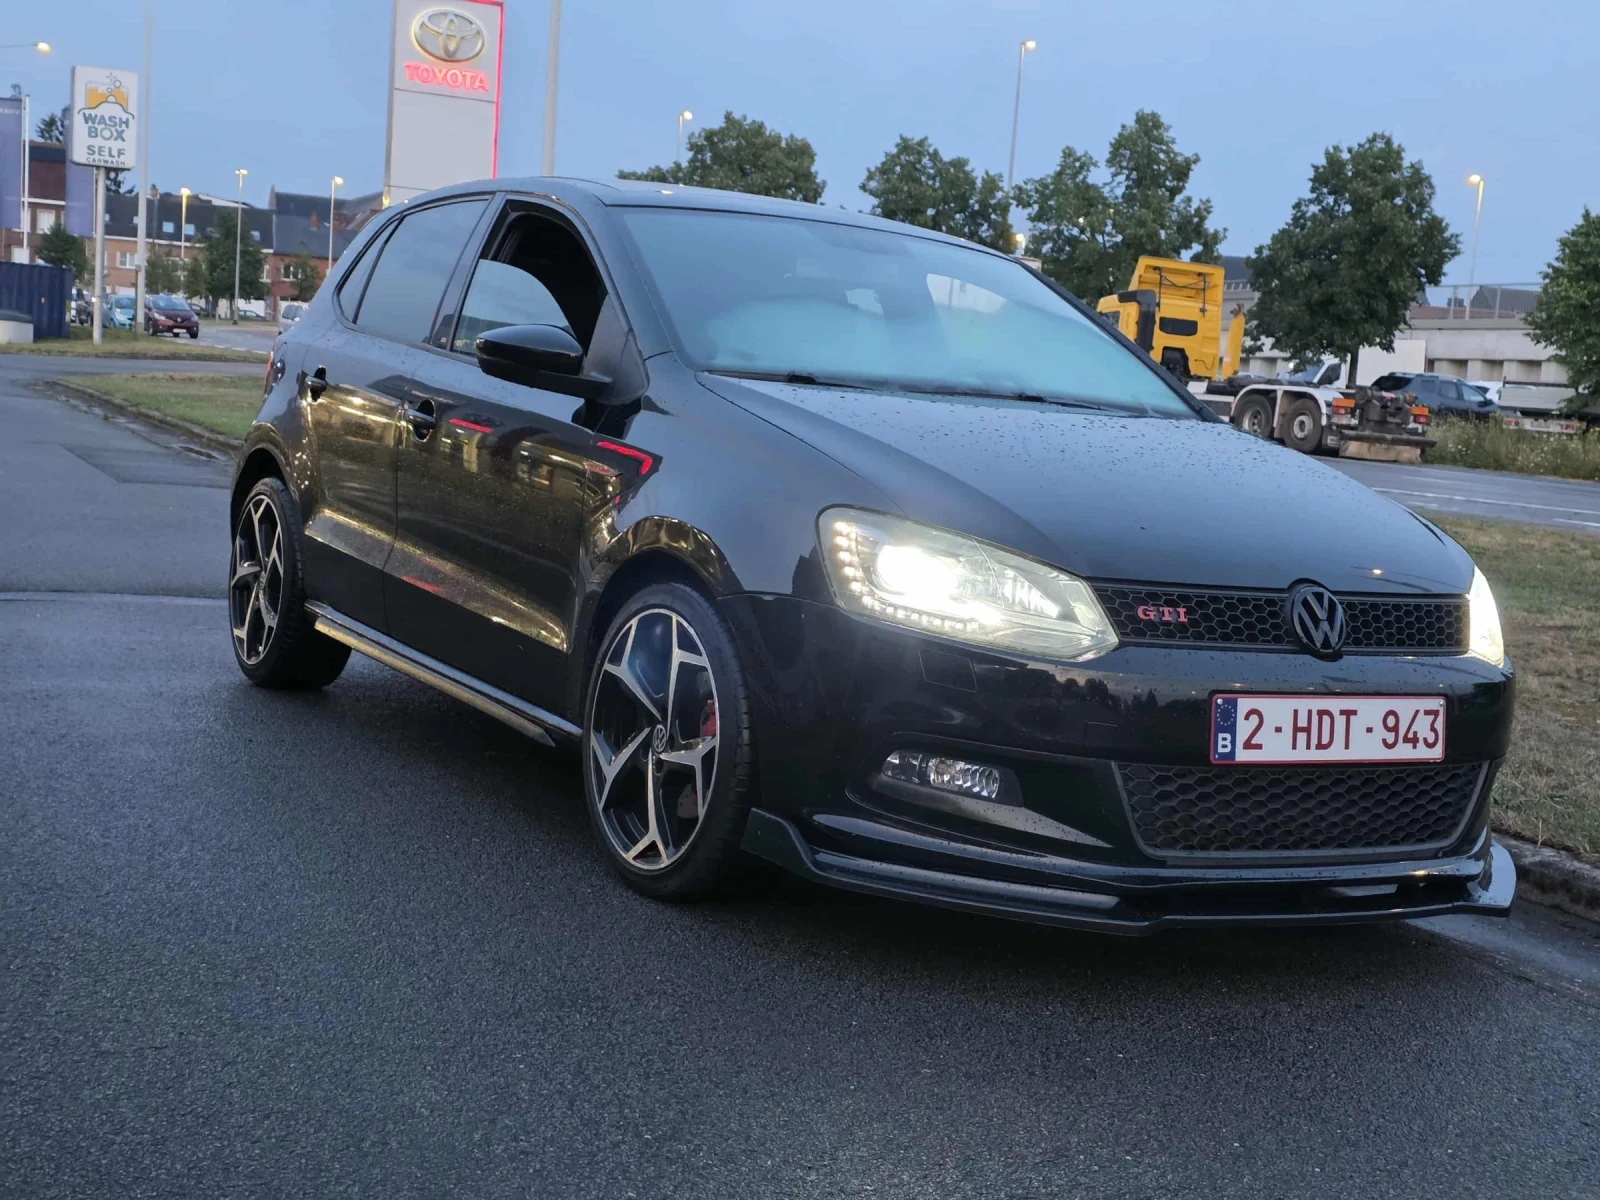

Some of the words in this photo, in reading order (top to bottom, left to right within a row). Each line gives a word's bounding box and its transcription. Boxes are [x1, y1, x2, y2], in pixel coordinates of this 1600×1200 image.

[403, 62, 488, 91] TOYOTA
[83, 112, 129, 128] WASH
[87, 126, 126, 142] BOX
[86, 144, 126, 158] SELF
[86, 156, 126, 166] CARWASH
[1137, 605, 1188, 622] GTI
[1217, 732, 1232, 753] B
